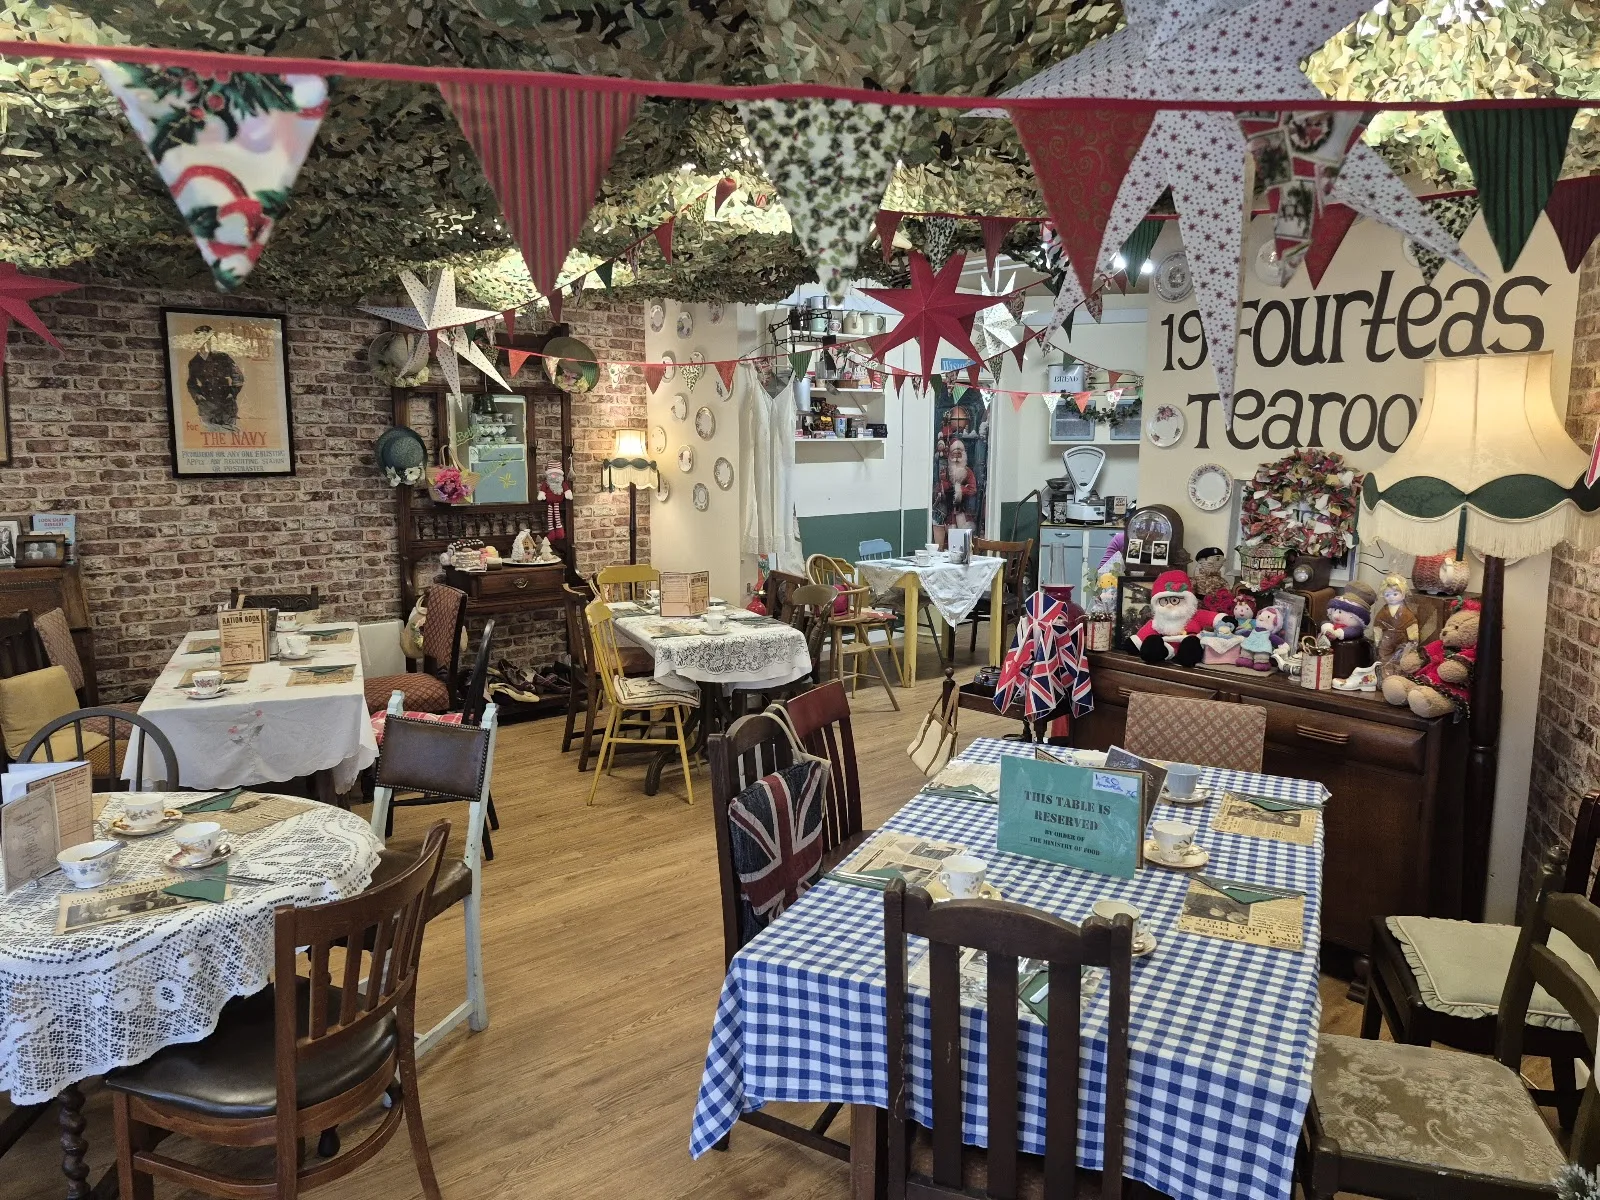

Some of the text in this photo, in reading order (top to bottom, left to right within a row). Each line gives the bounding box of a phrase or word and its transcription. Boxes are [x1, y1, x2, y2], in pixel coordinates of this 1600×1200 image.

[1054, 375, 1079, 383] BREAD
[1187, 388, 1422, 453] Tearoo
[200, 431, 267, 446] THE NAVY
[222, 615, 261, 625] RATION BOOK
[1024, 790, 1111, 816] THIS TABLE IS
[1034, 810, 1099, 831] RESERVED
[1054, 831, 1076, 841] ORDER
[1029, 836, 1042, 844] THE
[1042, 838, 1073, 850] MINISTRY
[1083, 847, 1100, 856] FOOD
